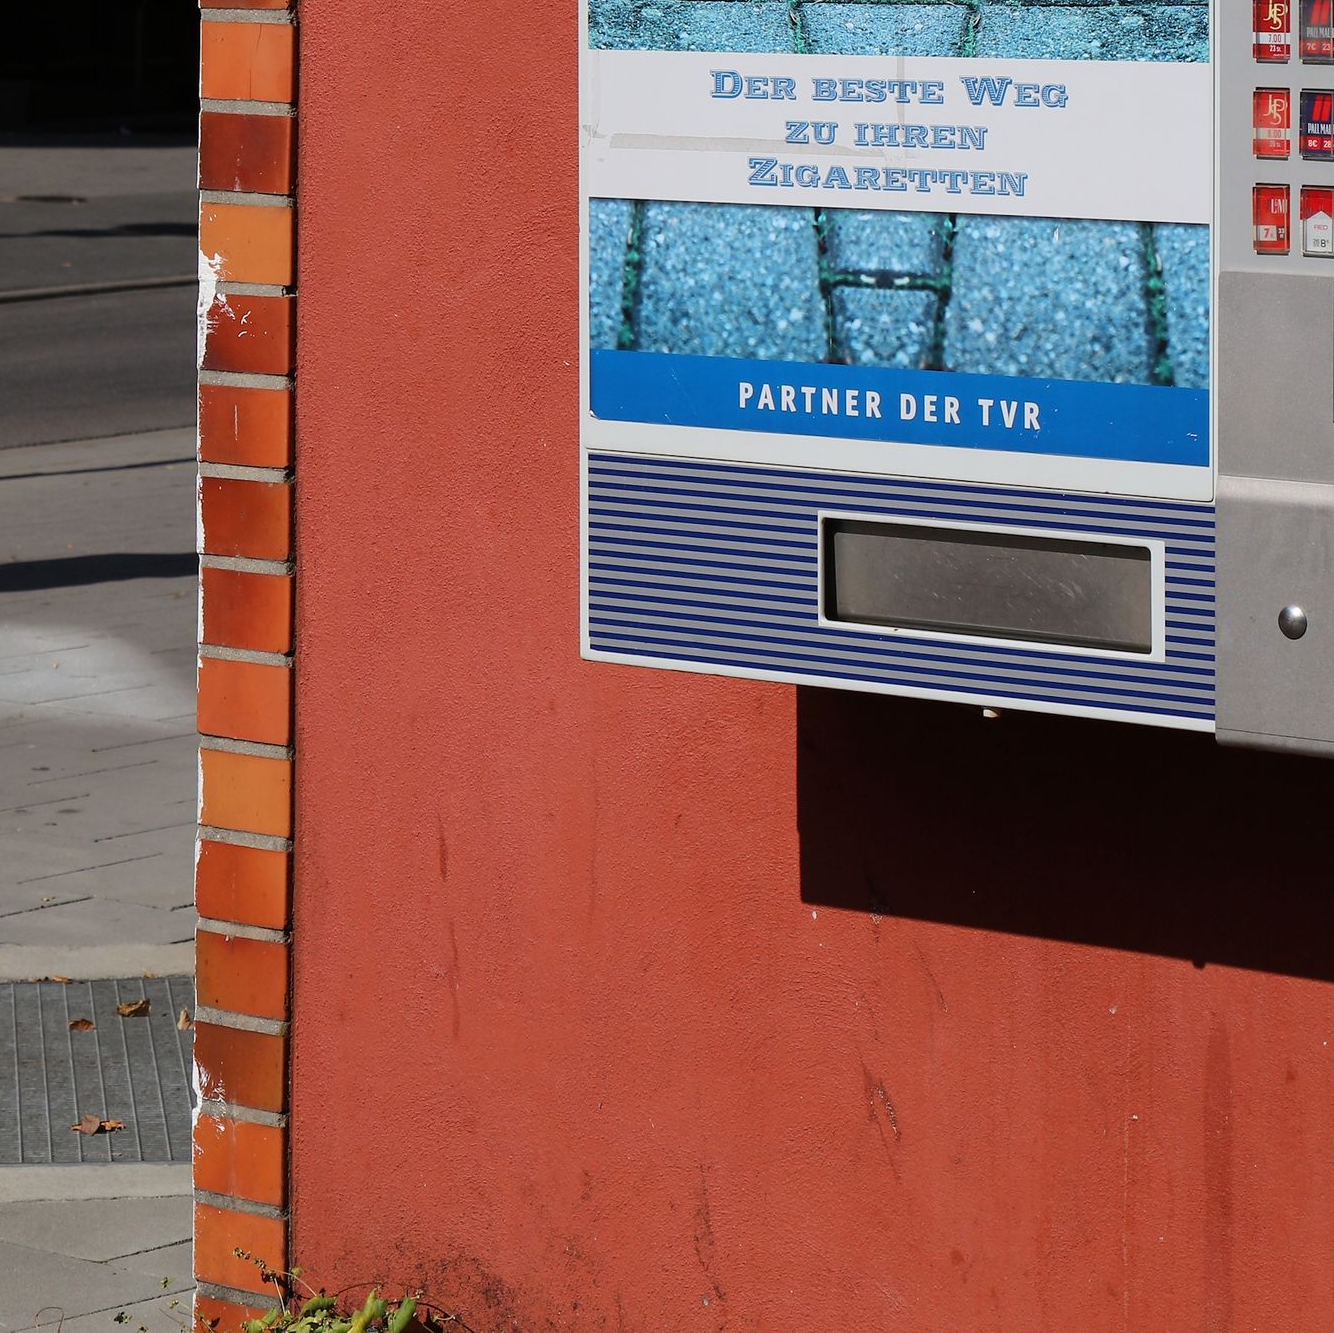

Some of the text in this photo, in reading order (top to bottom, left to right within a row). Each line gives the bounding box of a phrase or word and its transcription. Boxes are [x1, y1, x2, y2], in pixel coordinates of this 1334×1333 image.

[738, 381, 1042, 432] PARTNER DER TVR
